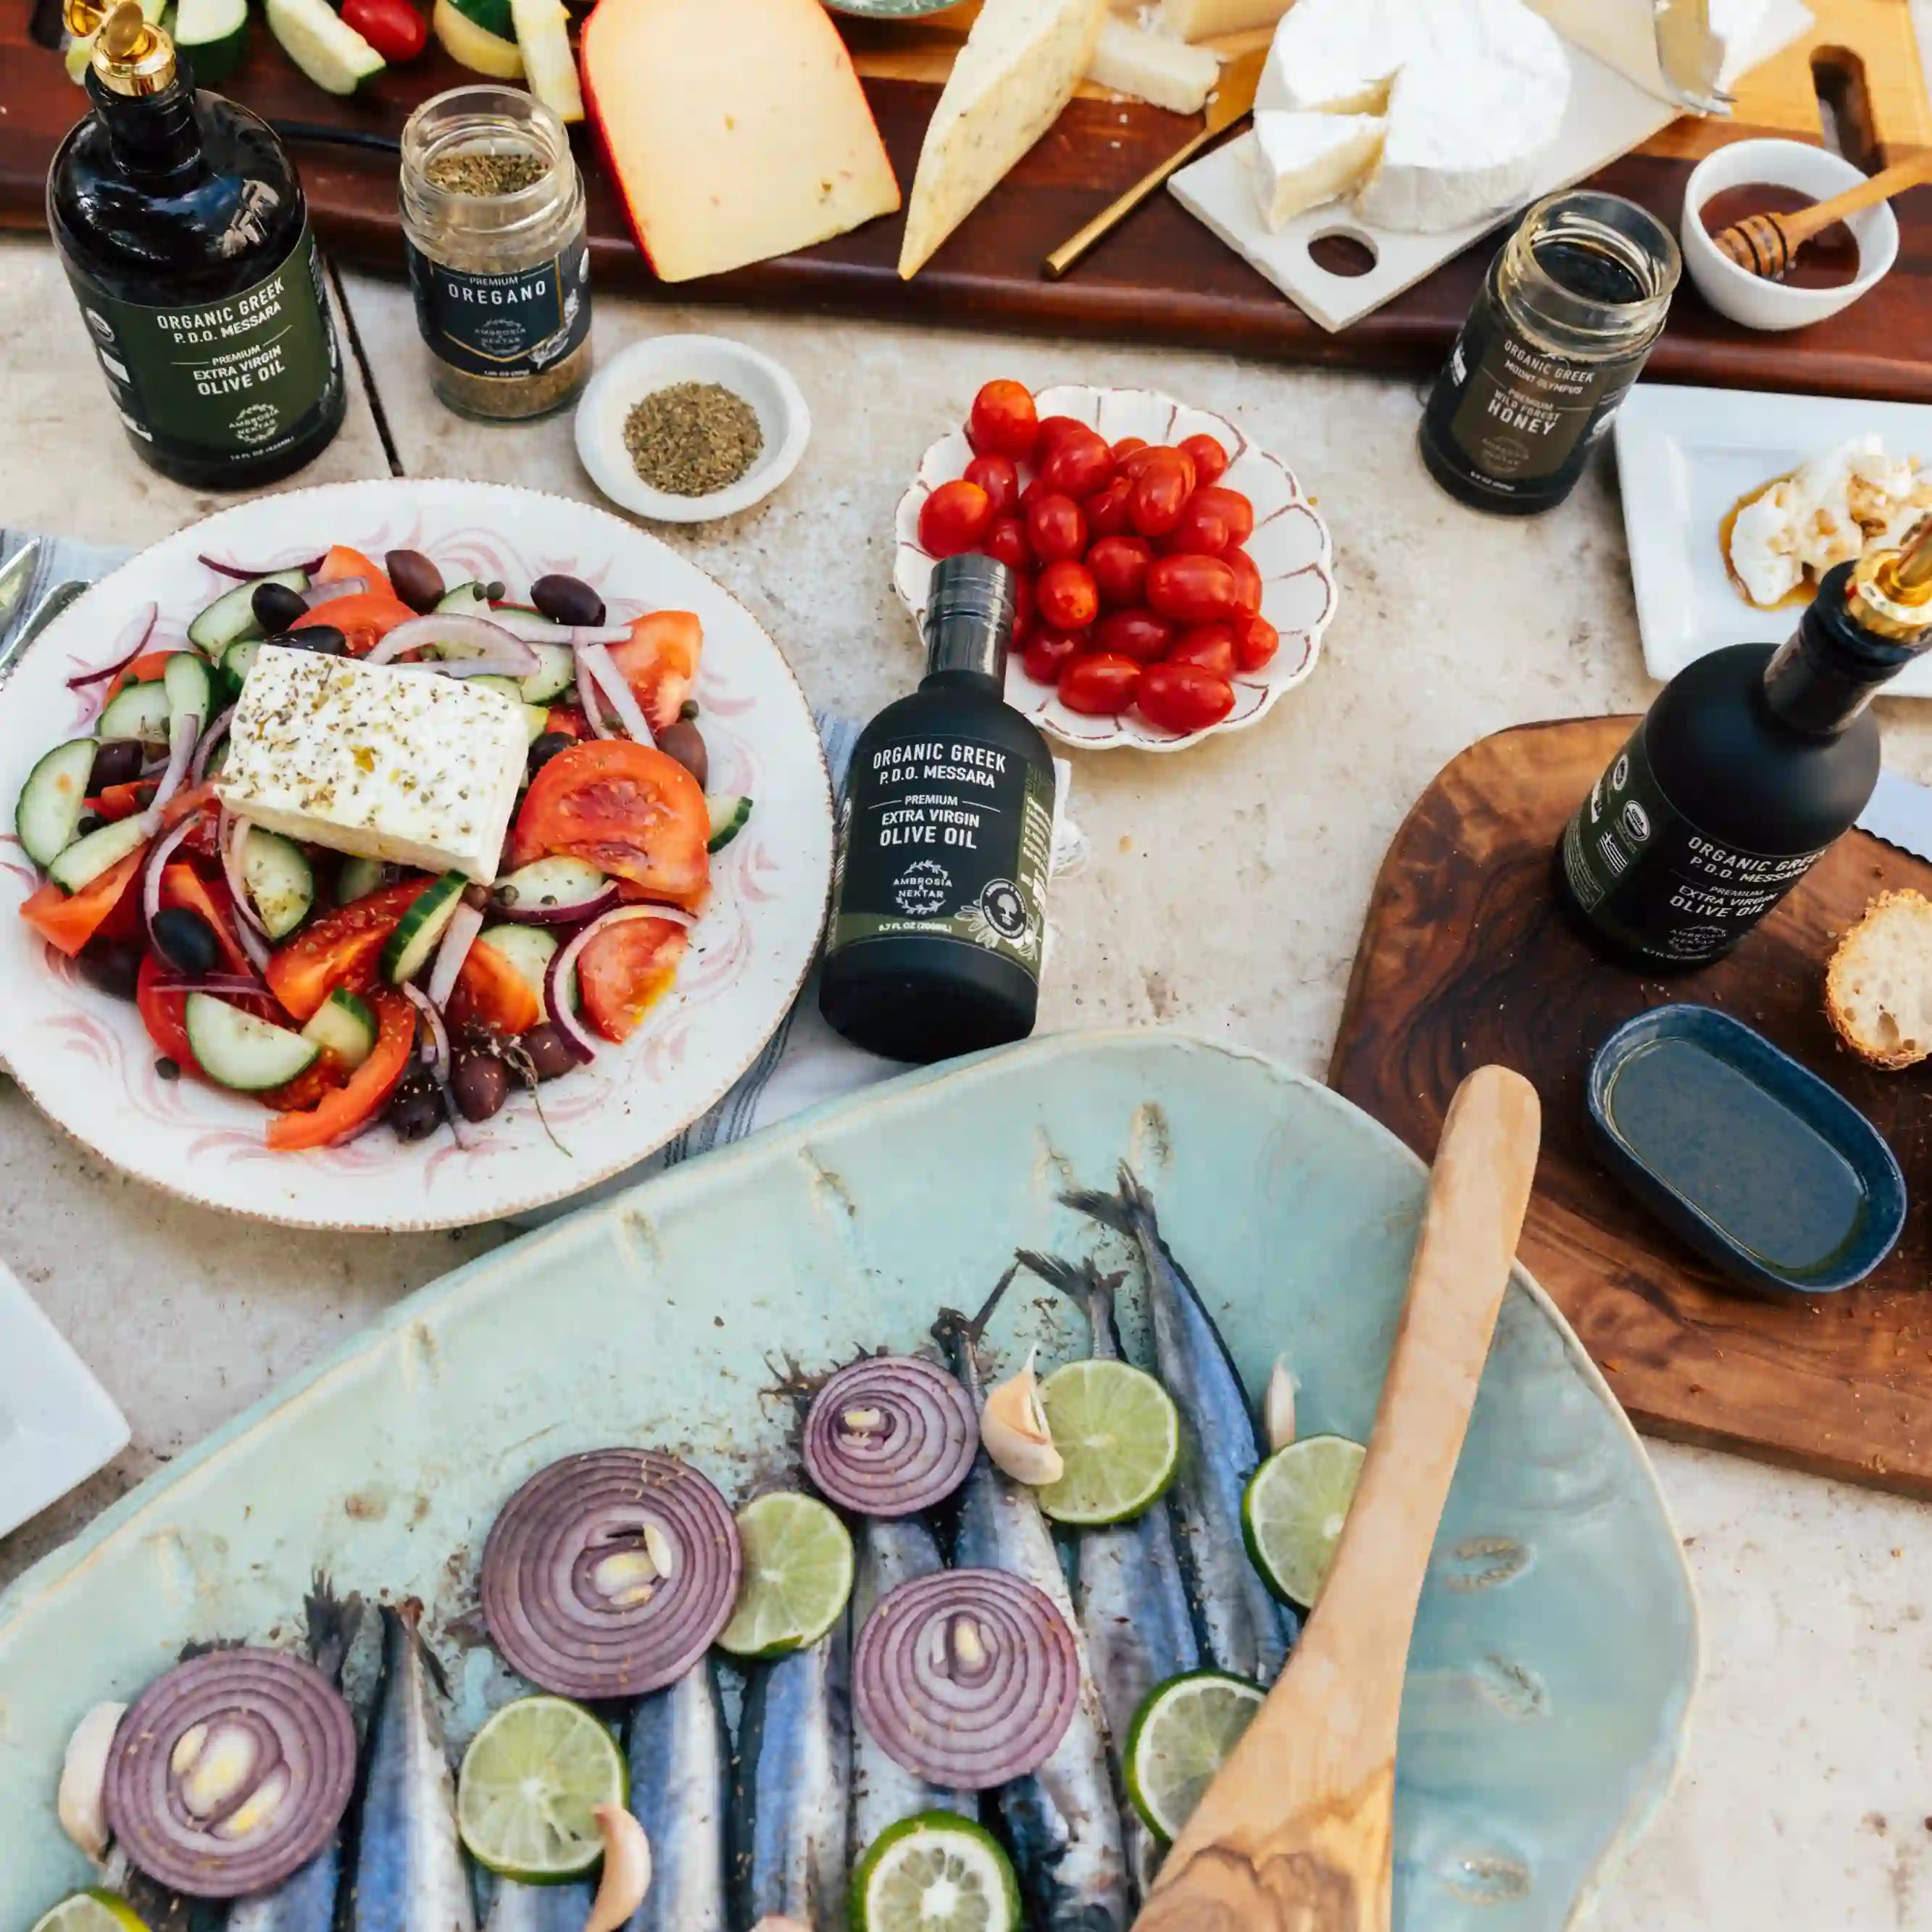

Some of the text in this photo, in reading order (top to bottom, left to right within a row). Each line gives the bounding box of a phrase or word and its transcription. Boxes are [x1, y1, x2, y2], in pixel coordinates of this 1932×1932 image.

[448, 280, 546, 304] OREGANO
[470, 276, 519, 287] PREMIUM
[157, 276, 285, 329] ORGANIC GREEK
[220, 301, 282, 338] MESSARA
[193, 345, 282, 380] EXTRA VIRGIN
[212, 344, 262, 366] PREMIUM
[1504, 339, 1596, 383] ORGANIC GREEK
[197, 360, 286, 395] OLIVE OIL
[1488, 399, 1557, 436] HONEY
[873, 743, 1007, 773] ORGANIC GREEK
[923, 765, 995, 788] MESSARA
[904, 794, 958, 806] PREMIUM
[881, 808, 980, 828] EXTRA VIRGIN
[880, 825, 978, 849] OLIVE OIL
[1688, 837, 1772, 872] ORGANIC
[892, 877, 952, 888] AMBROSIA
[899, 889, 944, 899] NEKTAR
[1709, 886, 1765, 897] PREMIUM
[1670, 896, 1765, 917] OLIVE OIL
[1678, 886, 1725, 905] EXTRA
